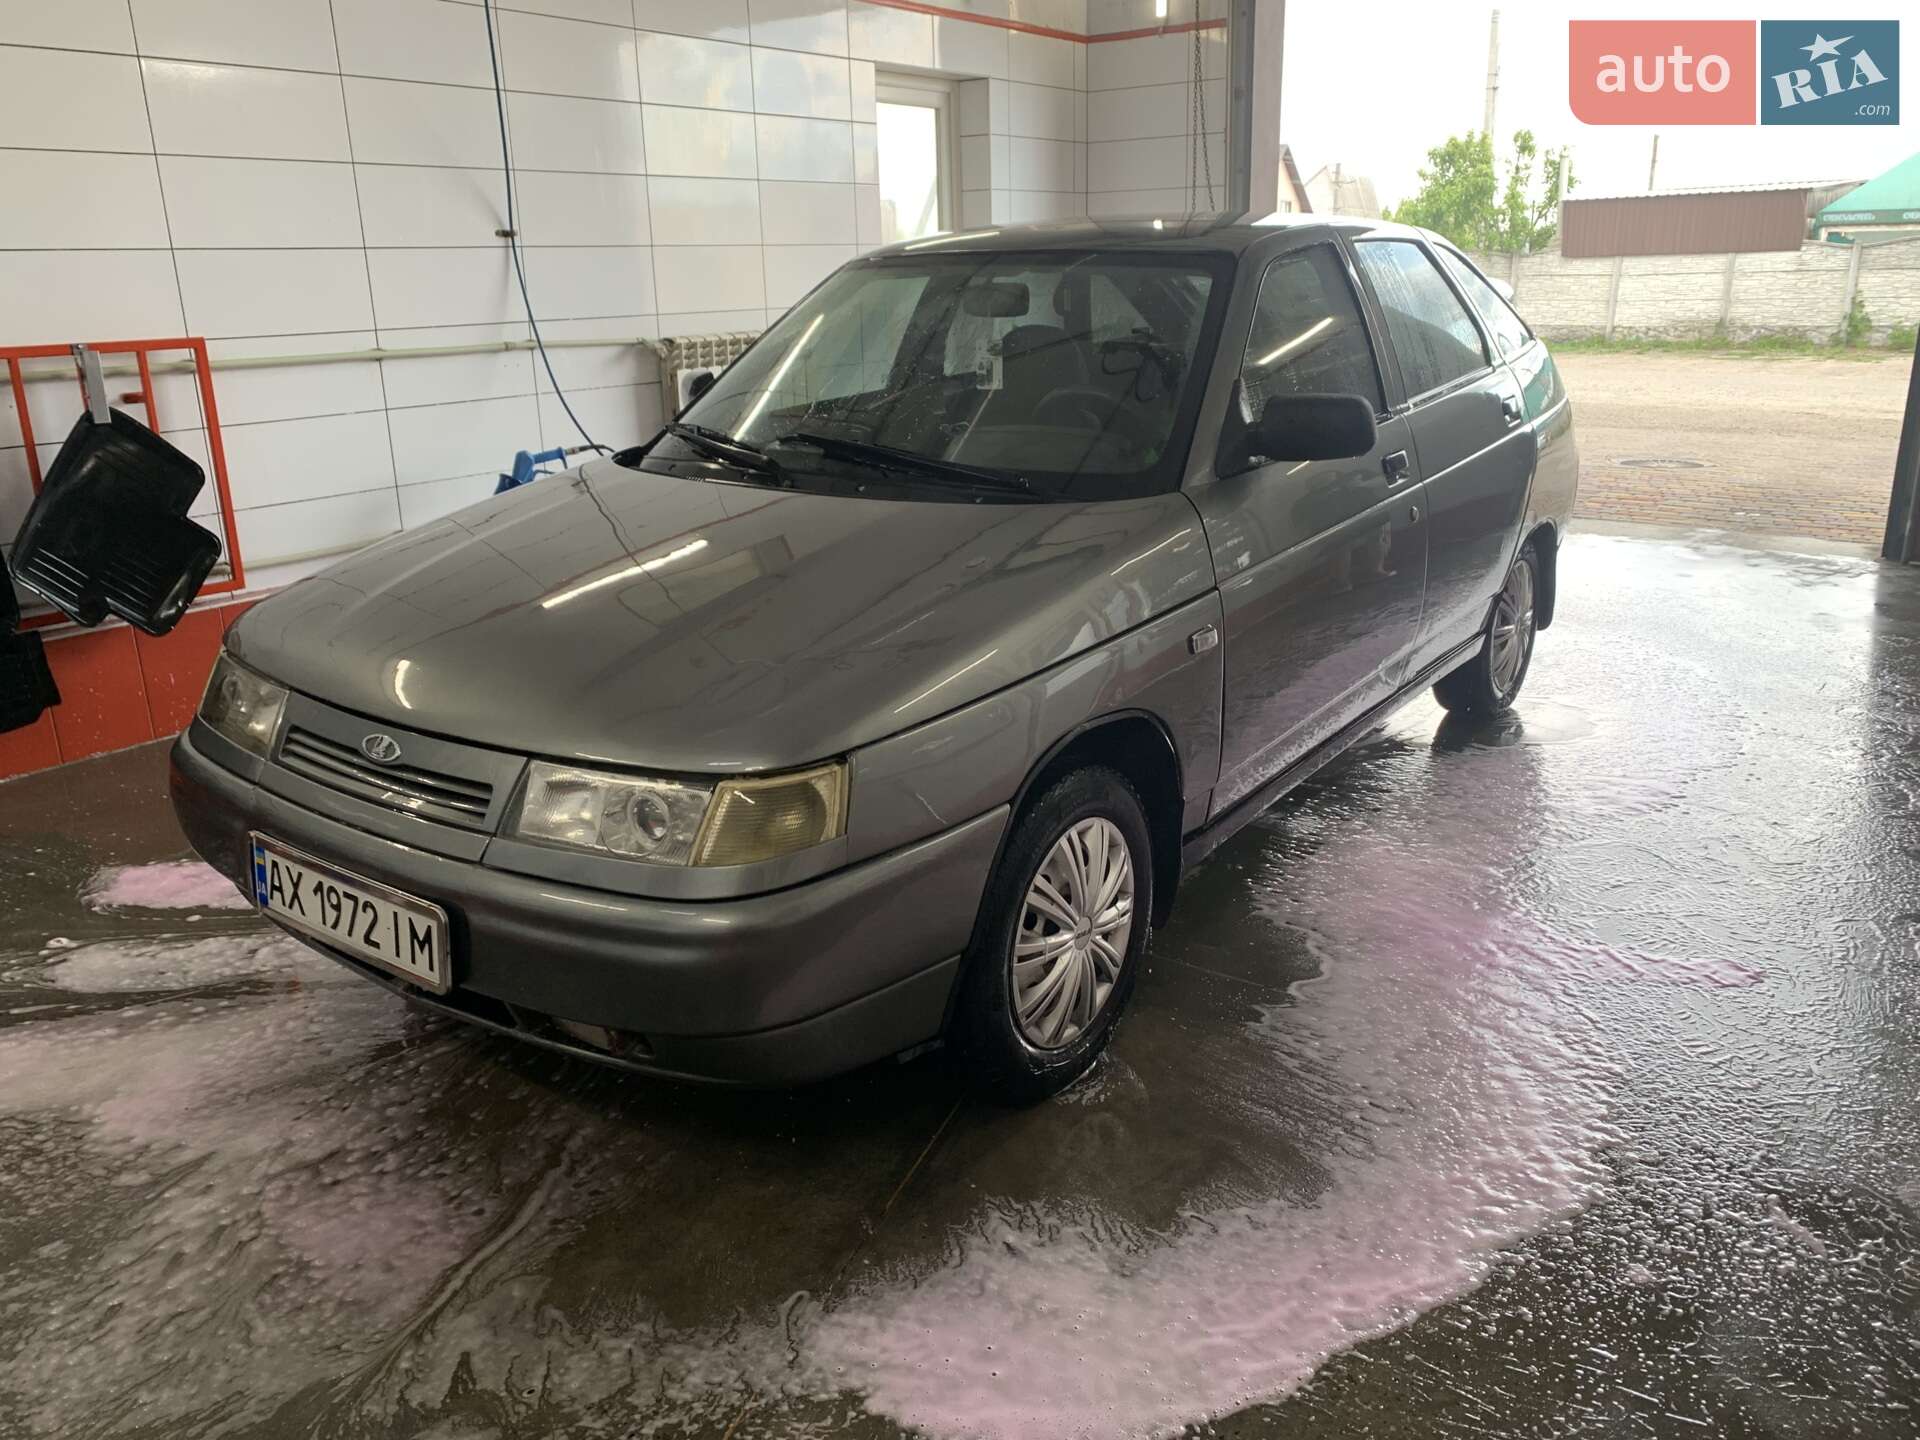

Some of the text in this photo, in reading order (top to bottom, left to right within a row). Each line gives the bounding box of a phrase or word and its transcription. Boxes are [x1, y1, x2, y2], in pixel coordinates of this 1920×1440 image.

[269, 859, 434, 972] AX 1972 IM
